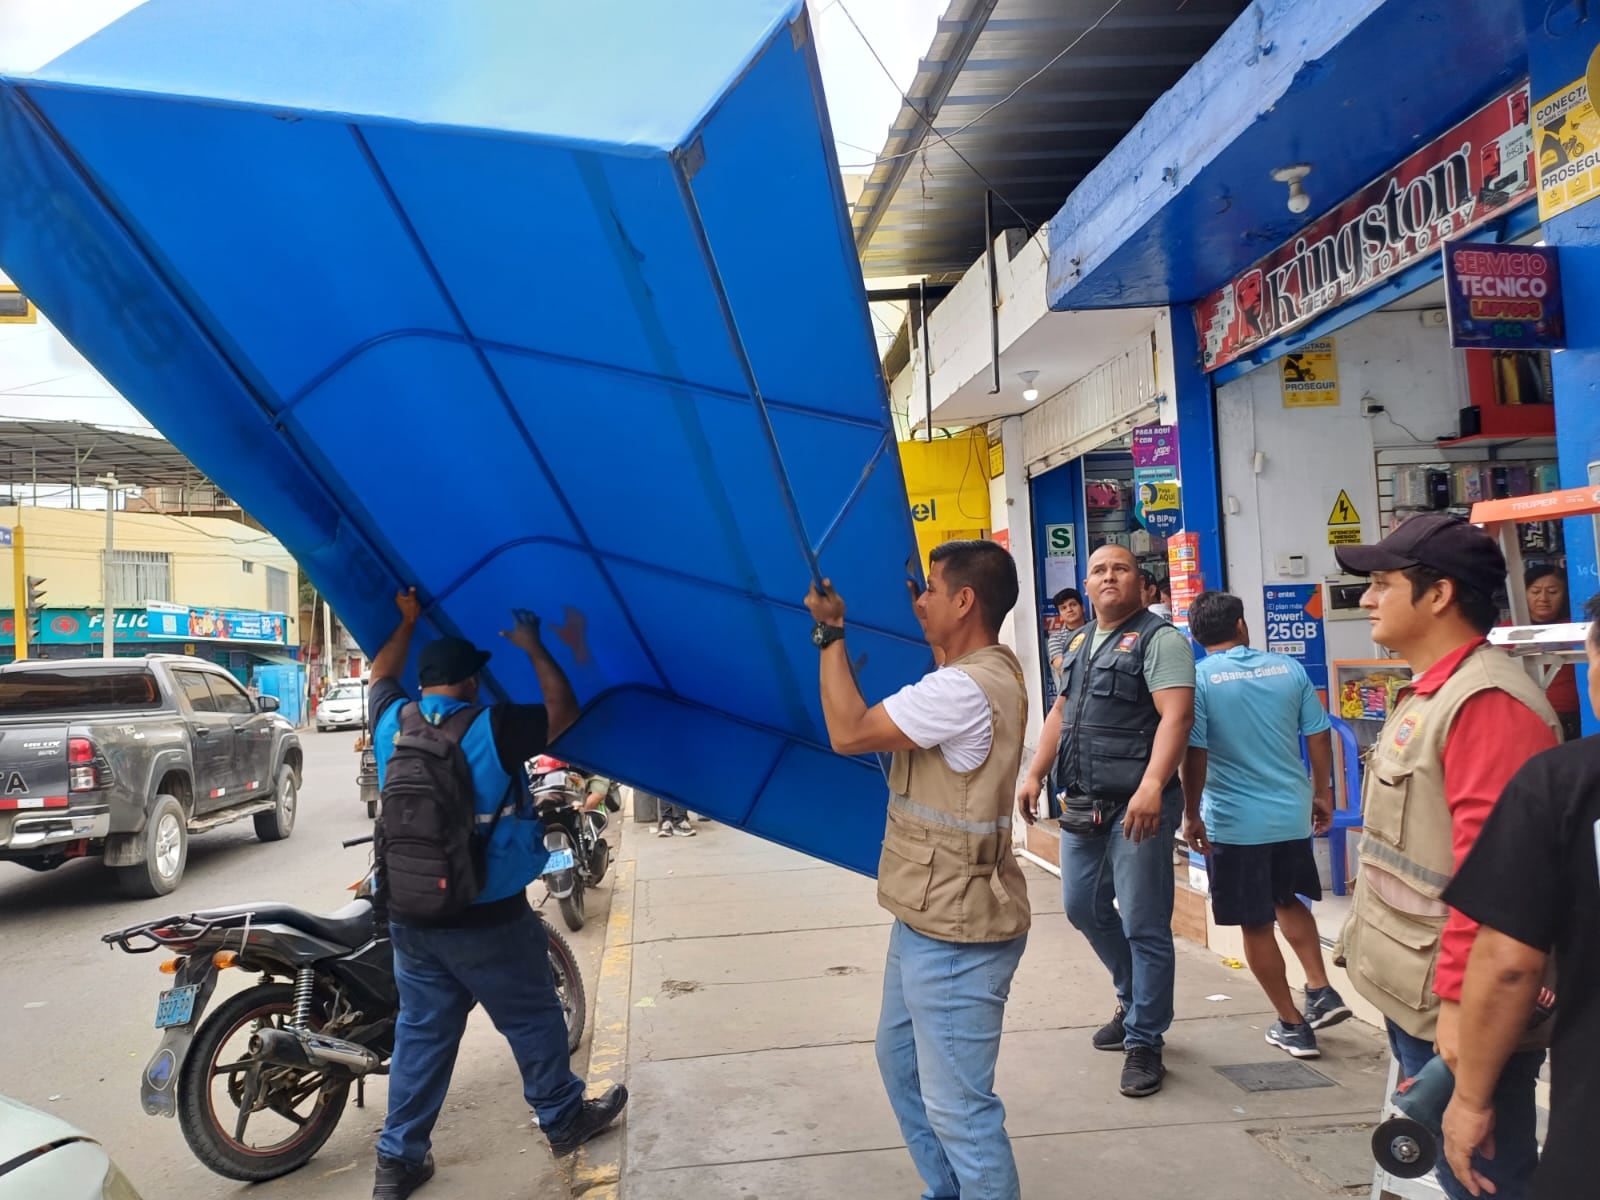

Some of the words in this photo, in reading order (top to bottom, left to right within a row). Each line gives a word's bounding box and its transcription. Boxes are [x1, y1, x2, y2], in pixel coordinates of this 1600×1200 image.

[1266, 150, 1475, 332] Kingston
[1300, 203, 1475, 318] TECHNOLOGY
[1454, 251, 1547, 275] SERVICIO
[1457, 275, 1547, 298] TECNICO
[1285, 381, 1336, 391] PROSEGUR
[1135, 428, 1153, 436] PAGA
[1512, 497, 1558, 511] TRUPER
[1051, 527, 1071, 549] S
[1275, 603, 1289, 611] plan
[1267, 611, 1304, 622] Power!
[1268, 622, 1318, 640] 25GB
[1221, 671, 1253, 681] Banco
